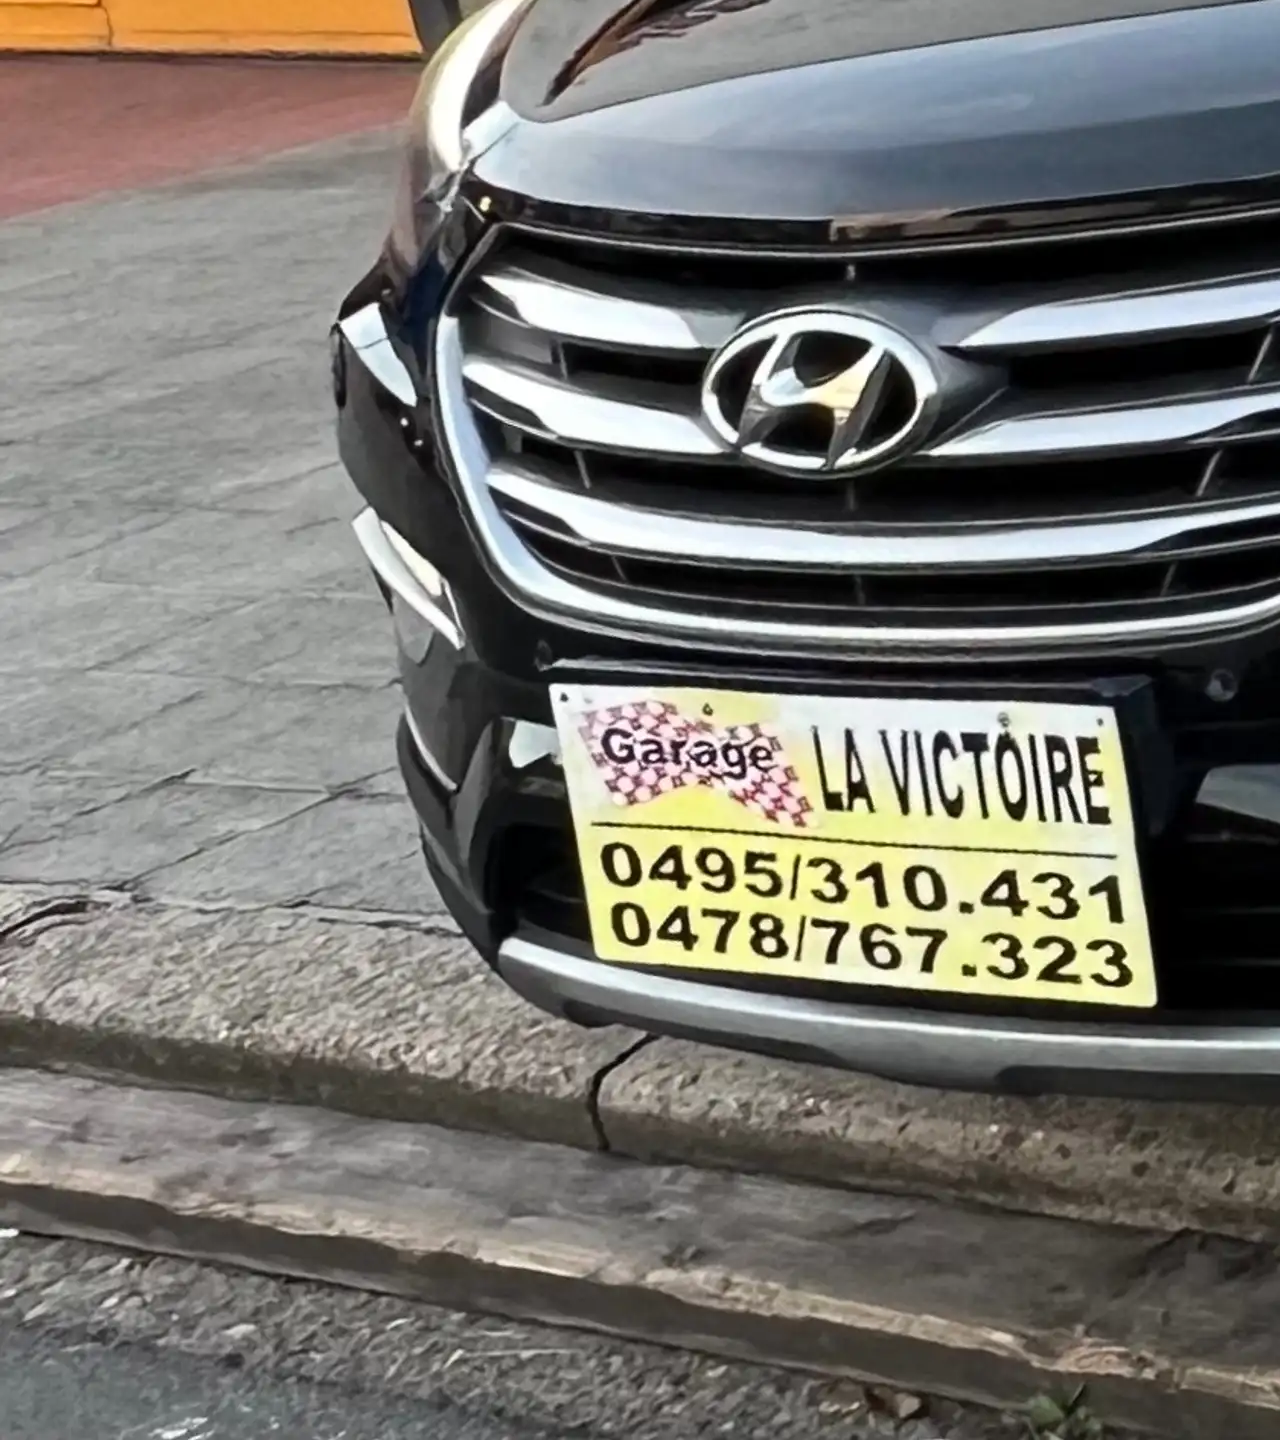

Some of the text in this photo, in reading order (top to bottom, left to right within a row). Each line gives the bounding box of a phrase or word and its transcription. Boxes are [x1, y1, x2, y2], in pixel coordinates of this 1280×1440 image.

[600, 726, 1113, 825] Garage LA VICTOIRE
[601, 841, 1125, 923] 0495/310.431
[610, 902, 1134, 987] 0478/767.323
